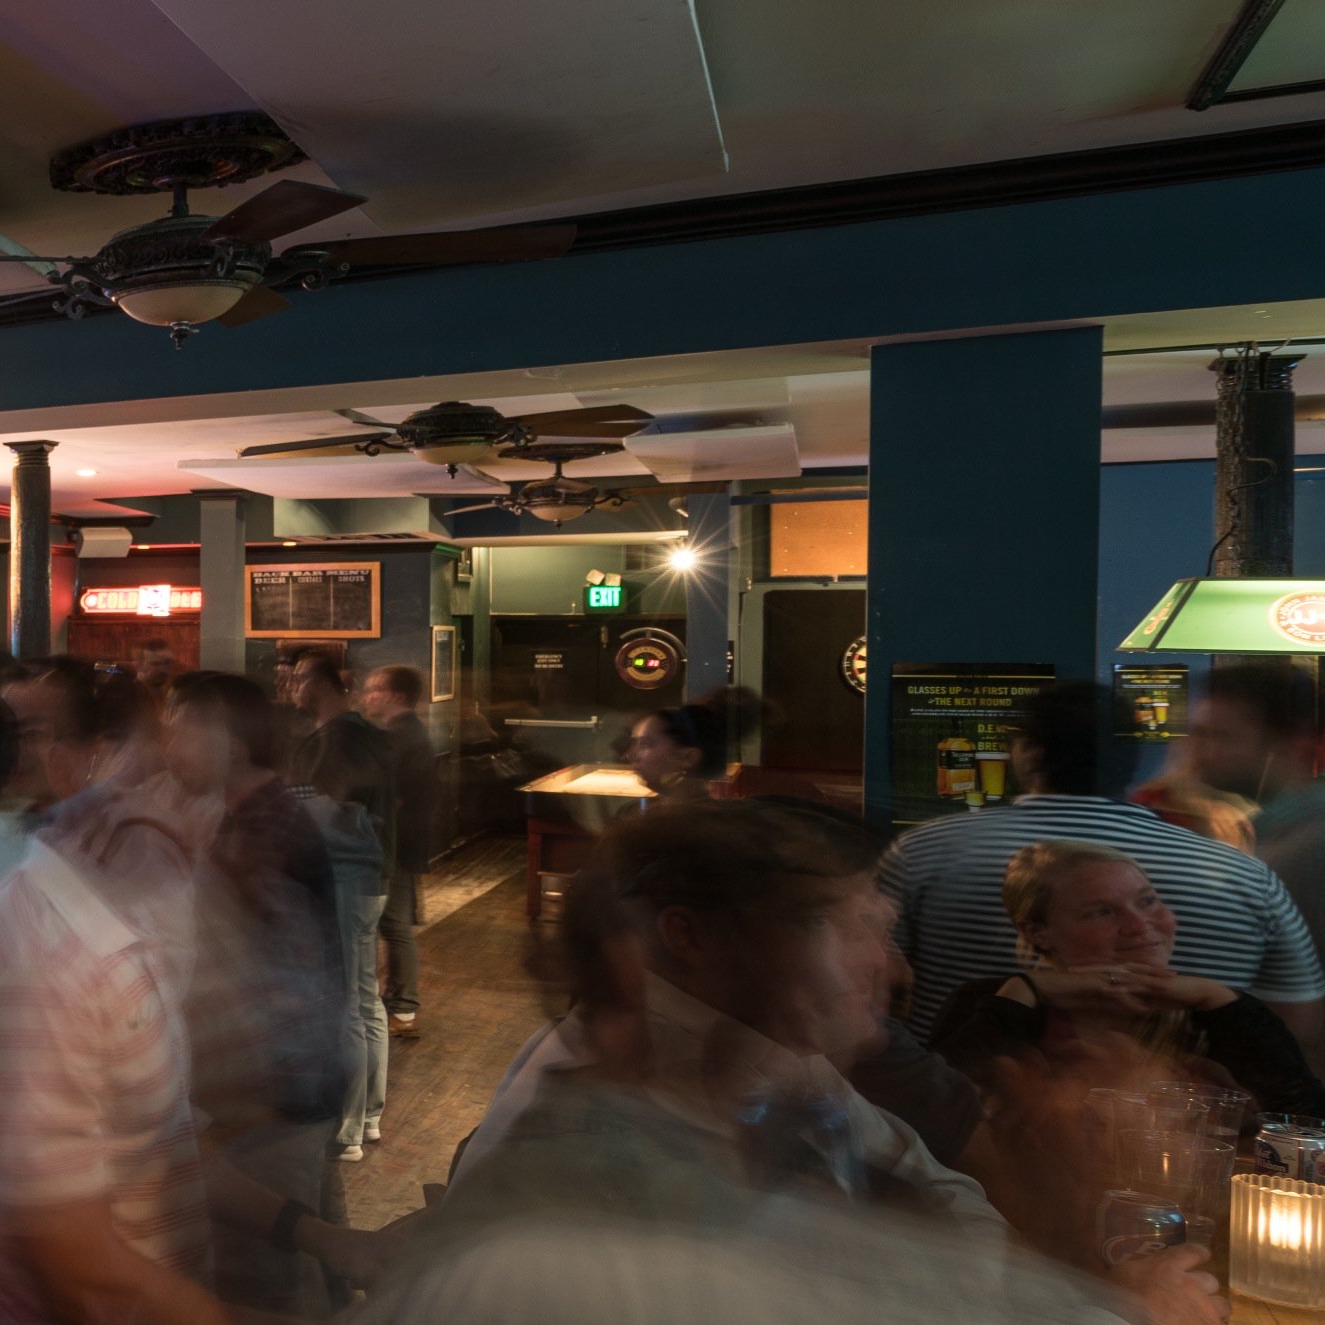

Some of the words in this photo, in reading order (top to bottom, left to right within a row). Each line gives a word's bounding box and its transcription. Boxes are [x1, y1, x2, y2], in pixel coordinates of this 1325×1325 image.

[253, 577, 287, 585] BEER
[337, 575, 365, 583] SHOTS
[96, 592, 138, 609] COLD
[170, 591, 202, 609] BEE
[588, 586, 621, 608] EXIT
[907, 686, 947, 695] GLASSES
[949, 686, 962, 695] UP
[973, 687, 981, 695] A
[982, 687, 1008, 695] FIRST
[1010, 687, 1040, 696] DOWN
[934, 697, 952, 706] THE
[954, 697, 976, 706] NEXT
[980, 697, 1013, 707] ROUND
